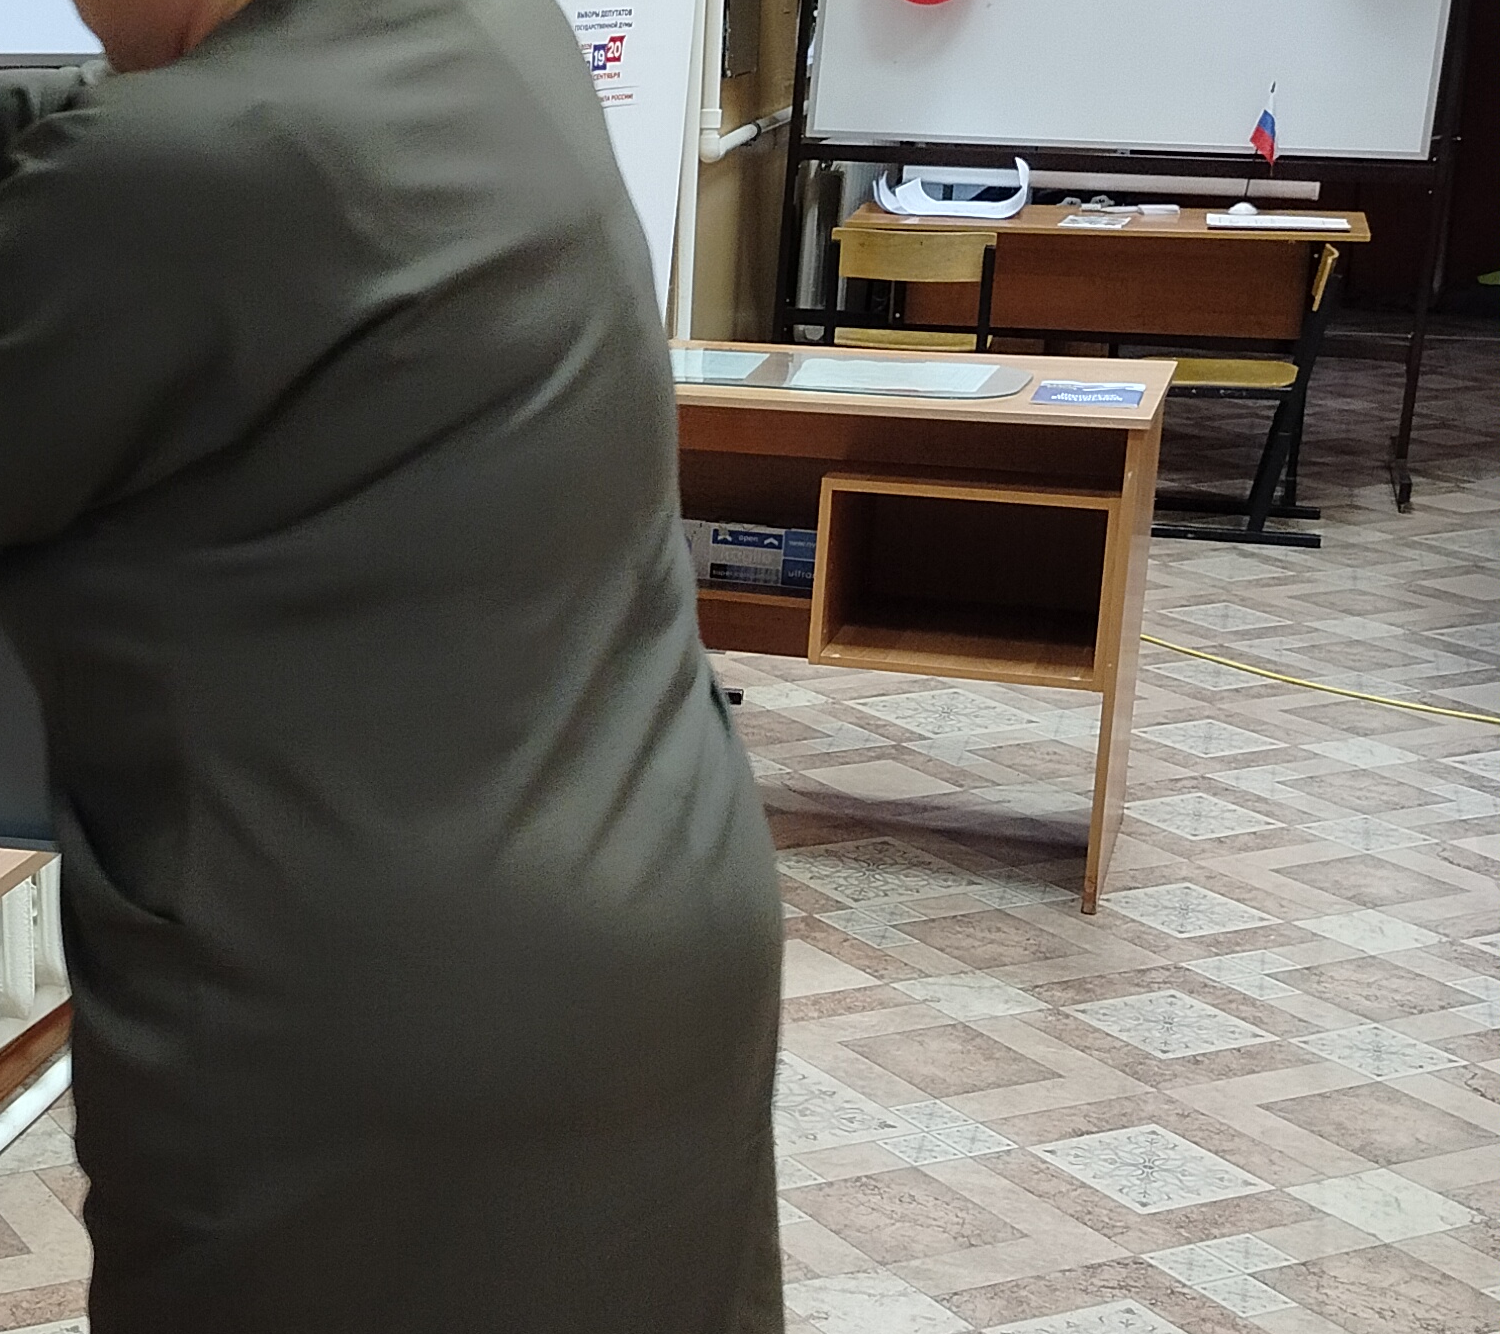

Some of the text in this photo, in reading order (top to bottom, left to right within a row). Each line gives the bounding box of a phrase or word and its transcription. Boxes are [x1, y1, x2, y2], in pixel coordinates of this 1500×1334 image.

[593, 41, 622, 67] 19 20
[738, 534, 759, 543] open
